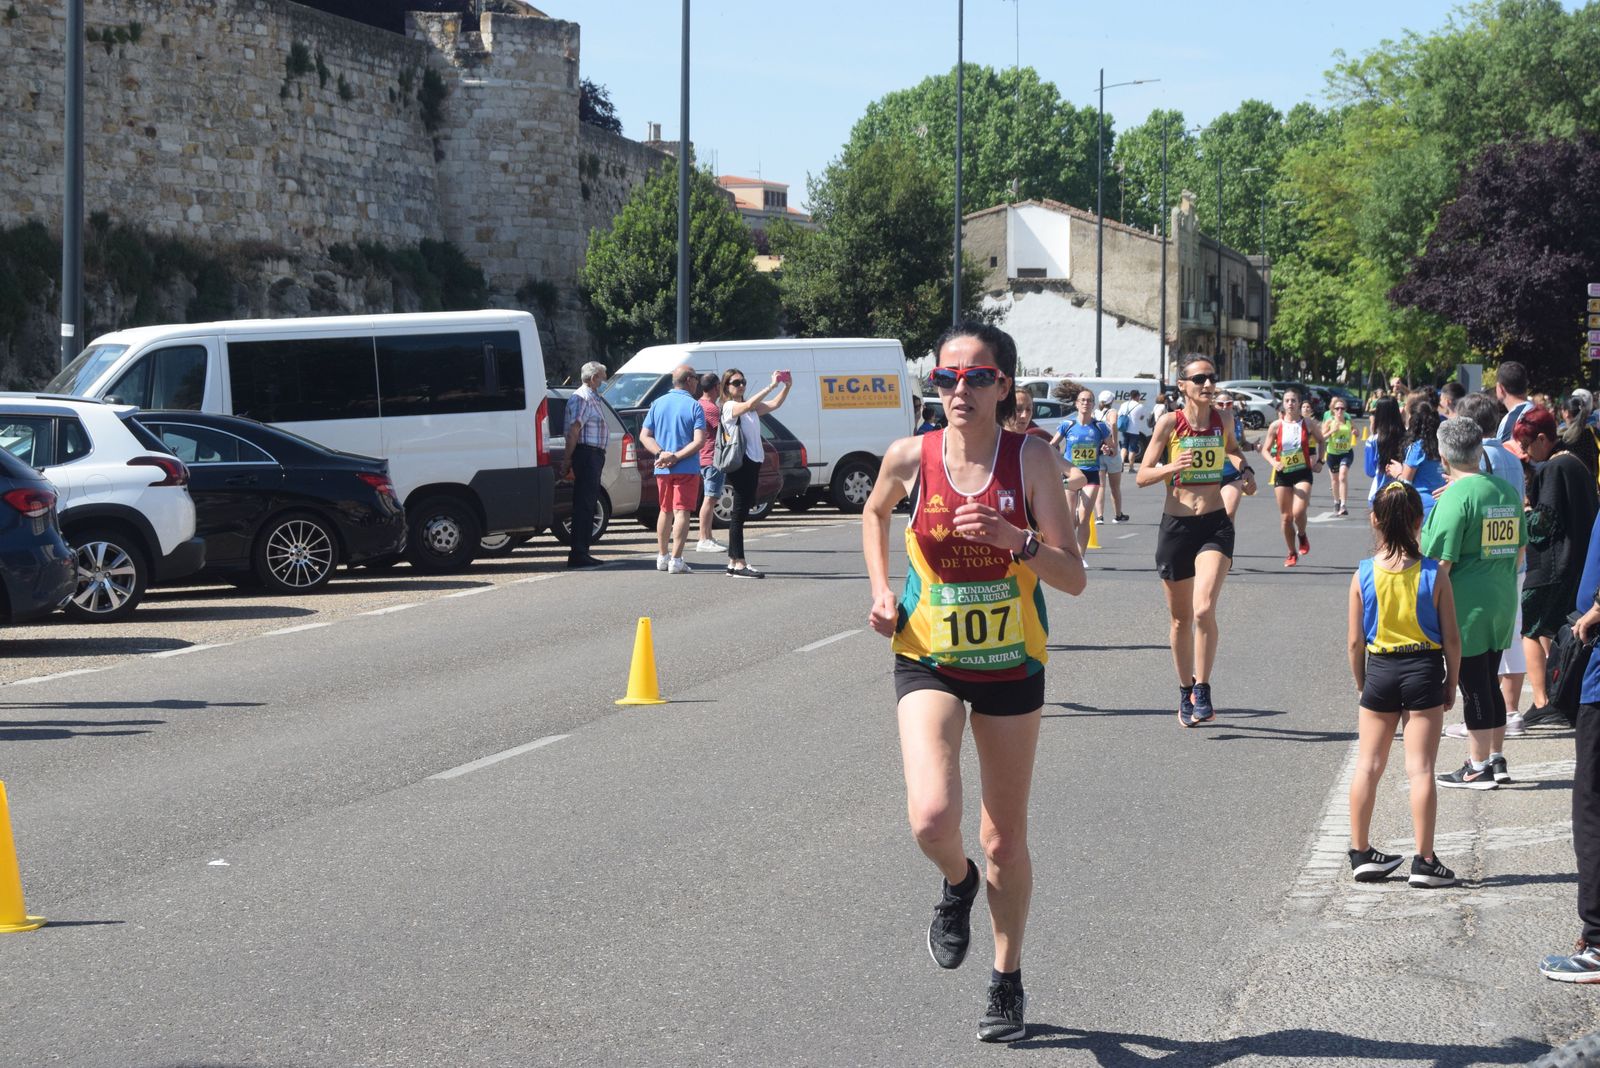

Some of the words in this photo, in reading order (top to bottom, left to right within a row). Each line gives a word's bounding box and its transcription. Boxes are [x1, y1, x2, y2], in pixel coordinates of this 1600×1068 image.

[1114, 390, 1147, 401] Hez
[1073, 449, 1094, 459] 242
[1192, 450, 1215, 468] 39
[1285, 454, 1299, 465] 26
[1486, 520, 1513, 541] 1026
[952, 545, 991, 556] VINO
[941, 558, 960, 568] DE
[962, 557, 1004, 568] TORO
[958, 594, 980, 603] CAJA
[982, 591, 1011, 602] RURAL
[943, 605, 1011, 646] 107
[960, 656, 986, 664] CAJA
[988, 650, 1022, 663] RURAL
